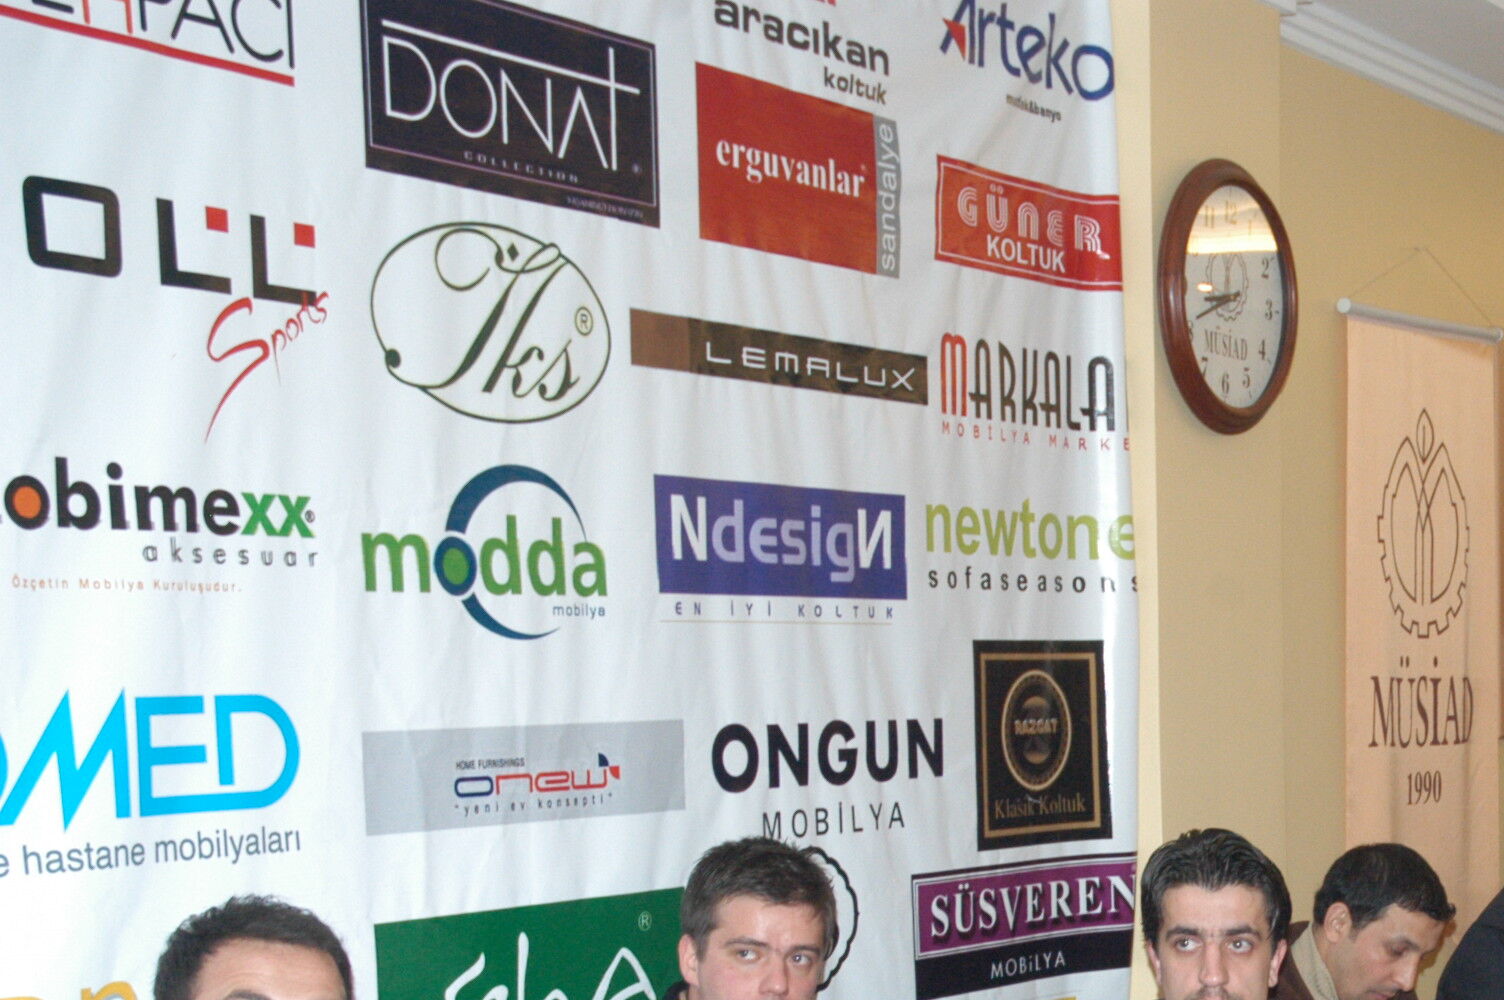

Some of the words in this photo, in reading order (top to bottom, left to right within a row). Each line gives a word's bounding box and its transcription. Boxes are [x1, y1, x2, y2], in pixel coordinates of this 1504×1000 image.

[715, 0, 889, 76] aracıkan
[940, 0, 1115, 101] Arteko
[381, 19, 640, 171] DONAT
[824, 66, 886, 105] koltuk
[716, 139, 866, 199] erguvanlar
[878, 122, 900, 272] sandalye
[986, 233, 1066, 274] KOLTUK
[204, 291, 330, 443] Sports
[706, 340, 916, 392] LEMALUX
[0, 456, 315, 538] obimexx
[142, 537, 319, 568] aksesuar
[361, 514, 608, 598] modda
[925, 498, 1135, 561] newtone
[79, 577, 145, 592] Mobilya
[552, 602, 606, 620] mobilya
[675, 601, 702, 616] EN
[798, 604, 893, 619] KOLTUK
[1368, 656, 1474, 749] MÜSİAD
[0, 687, 300, 833] MED
[454, 767, 609, 798] onew
[711, 717, 945, 793] ONGUN
[1039, 792, 1087, 816] Koltuk
[1406, 770, 1442, 807] 1990
[22, 842, 146, 875] hastane
[154, 826, 301, 864] mobilyaları
[762, 800, 906, 842] MOBİLYA
[930, 873, 1136, 939] SÜSVEREN
